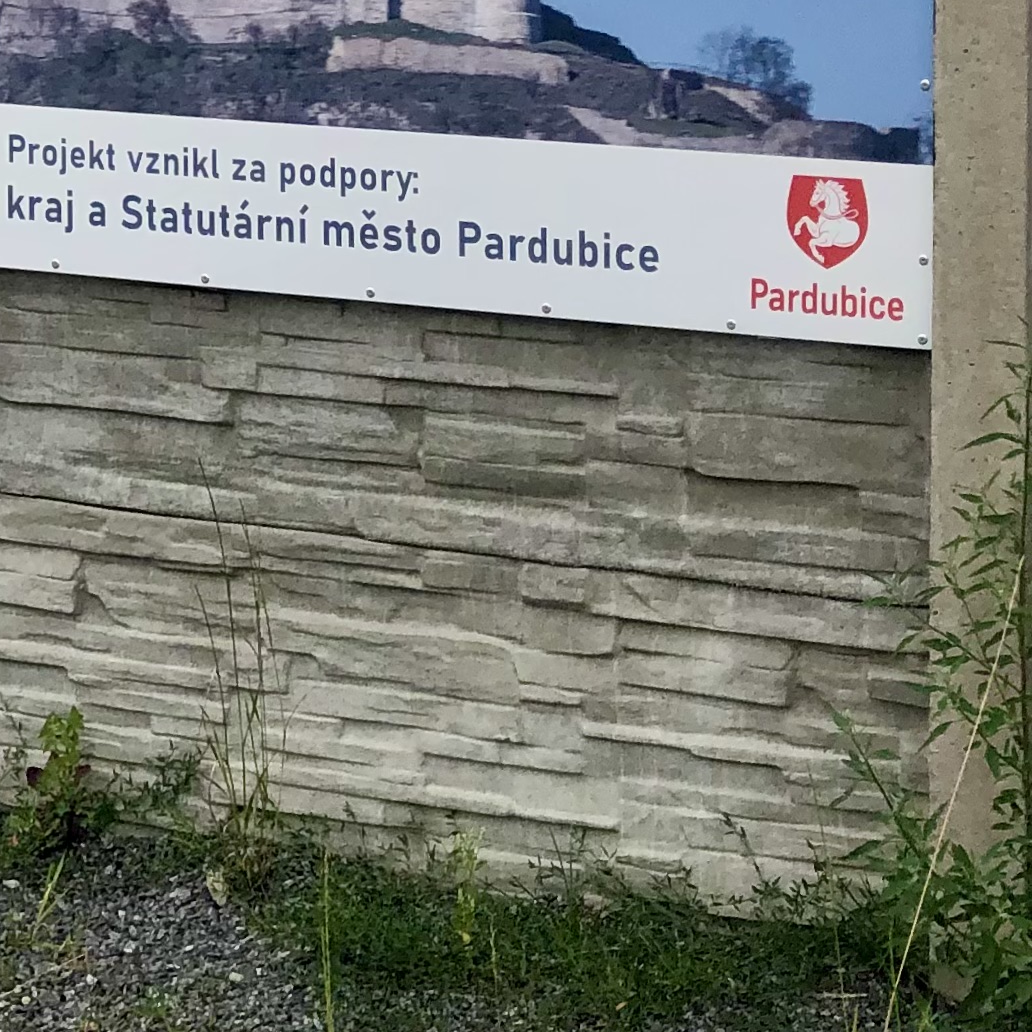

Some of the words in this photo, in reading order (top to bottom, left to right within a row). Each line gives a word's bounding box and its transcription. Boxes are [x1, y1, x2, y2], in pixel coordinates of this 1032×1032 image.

[8, 133, 116, 176] Projekt
[127, 146, 220, 179] vznikl
[232, 158, 266, 183] za
[279, 157, 419, 202] podpory:
[7, 184, 74, 234] kraj
[88, 200, 106, 227] a
[121, 194, 309, 244] Statutární
[323, 209, 441, 255] město
[458, 220, 660, 273] Pardubice
[750, 277, 904, 322] Pardubice
